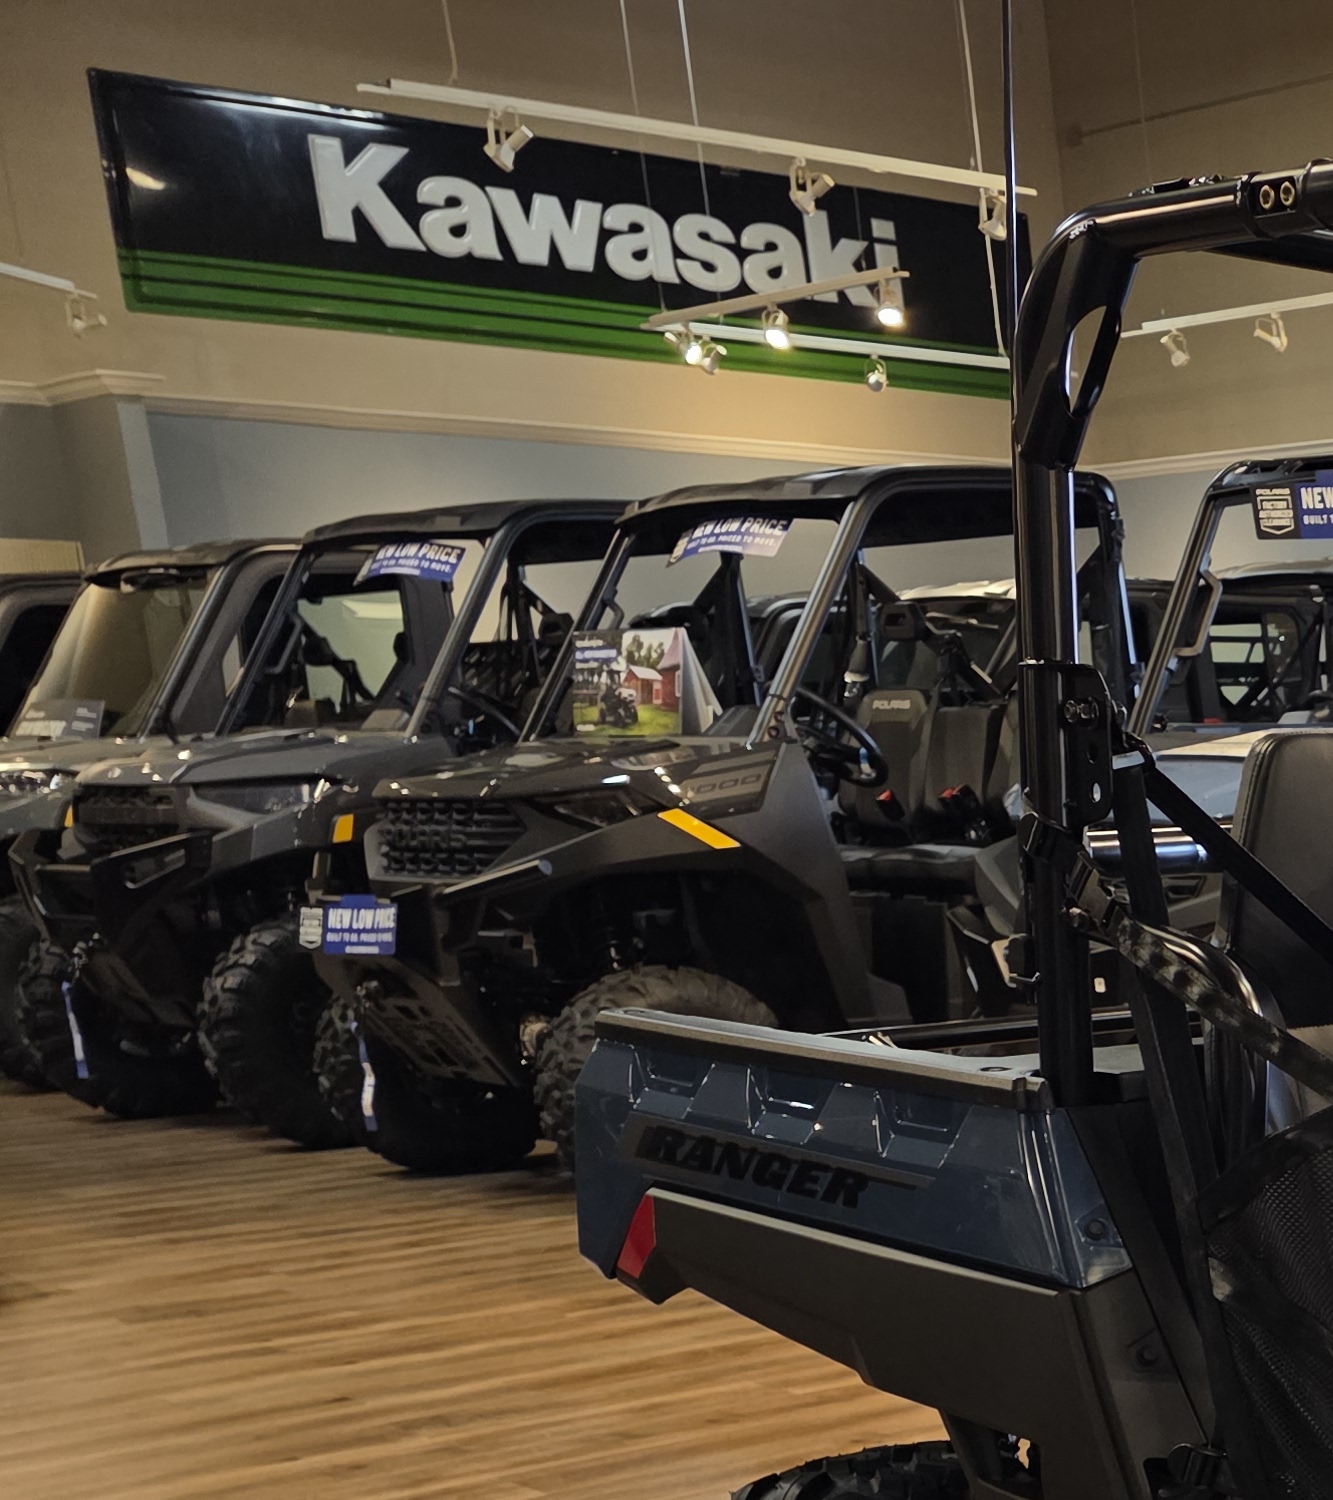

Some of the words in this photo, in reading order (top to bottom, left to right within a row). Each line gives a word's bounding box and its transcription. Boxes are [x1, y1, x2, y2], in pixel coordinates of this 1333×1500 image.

[307, 133, 901, 308] Kawasaki
[741, 517, 788, 535] PRICE
[418, 543, 461, 563] PRICE
[328, 908, 352, 929] NEW
[352, 908, 374, 929] LOW
[636, 1125, 874, 1210] RANGER
